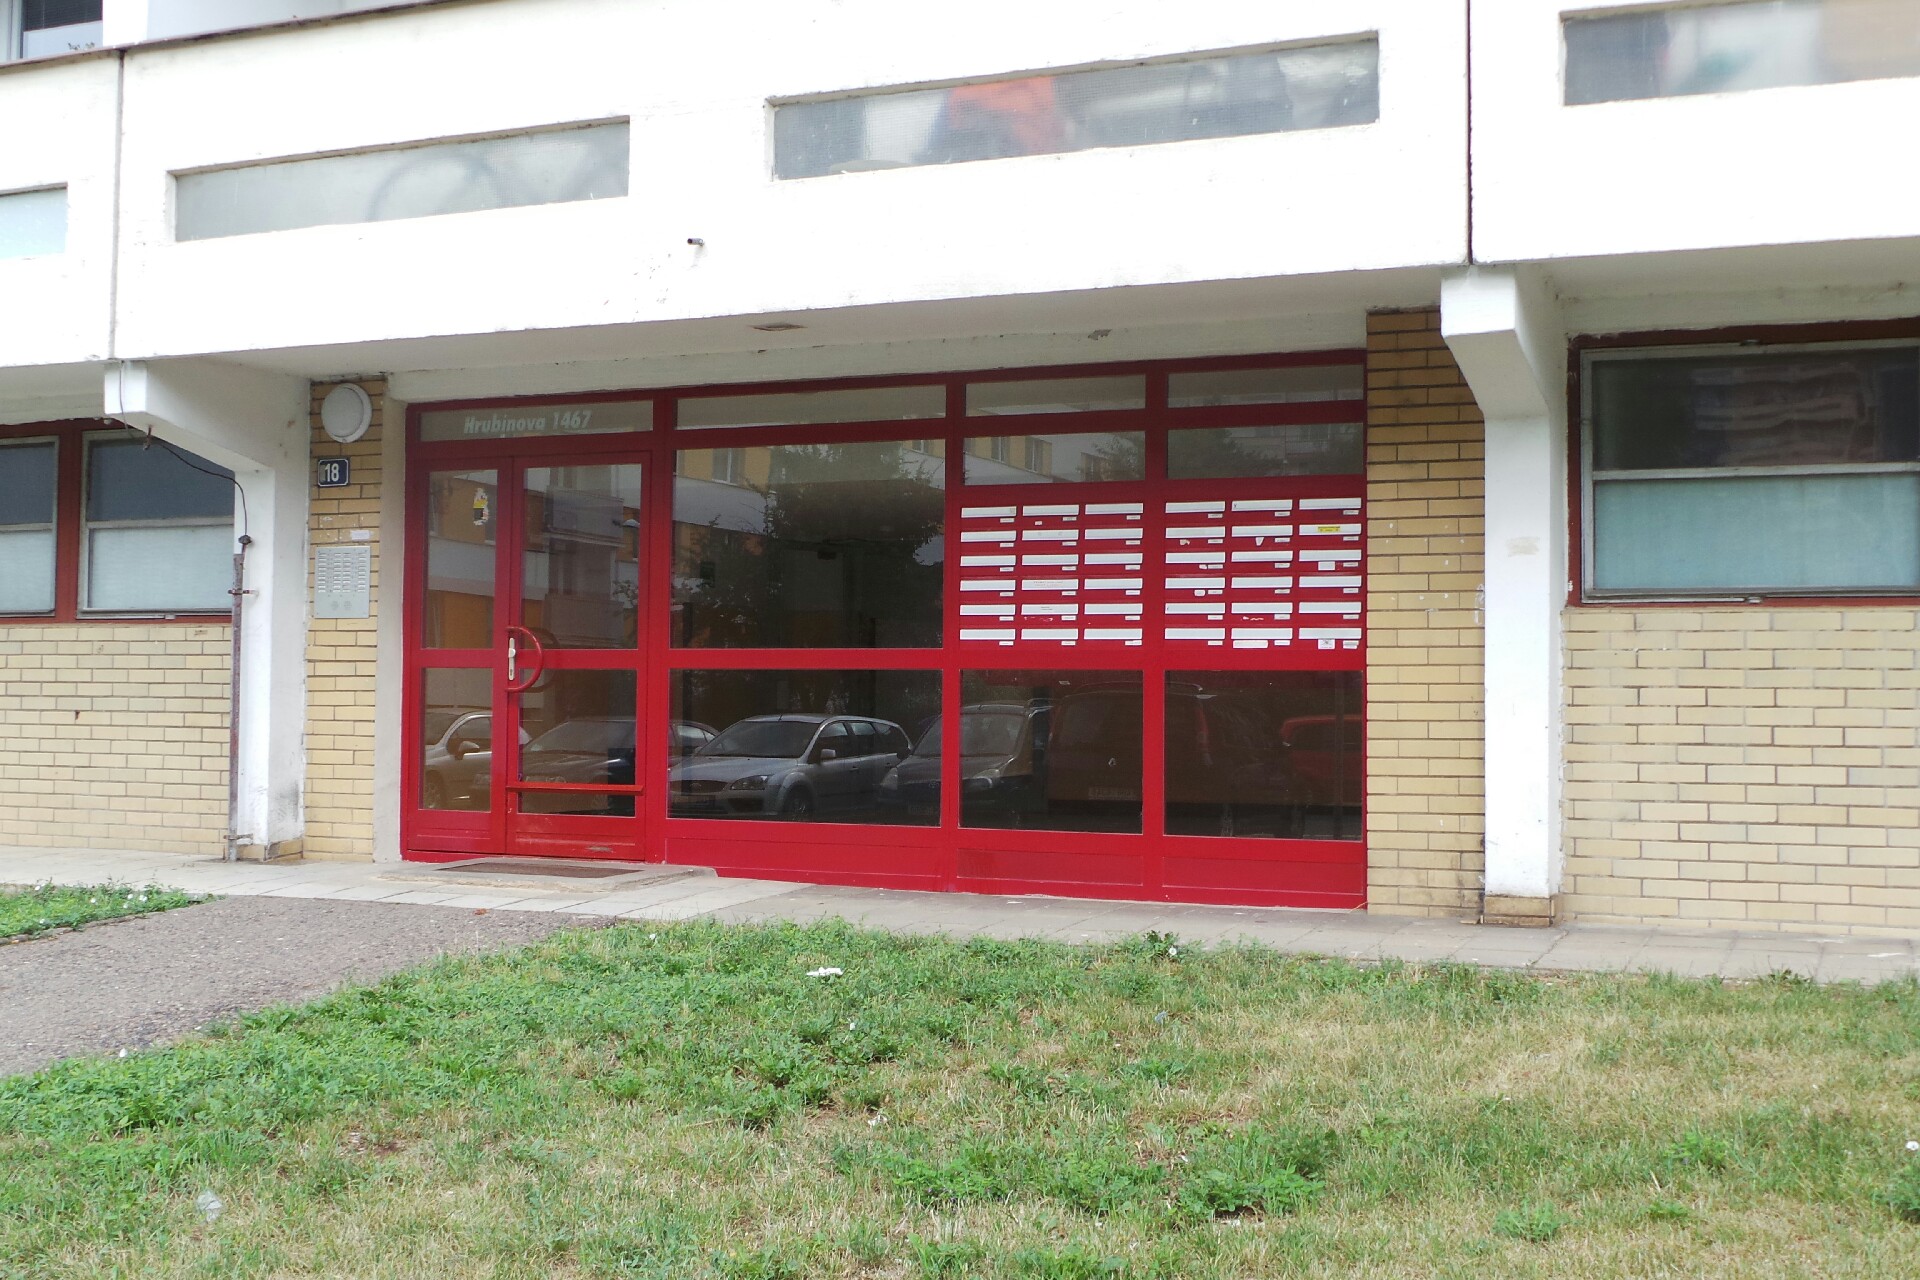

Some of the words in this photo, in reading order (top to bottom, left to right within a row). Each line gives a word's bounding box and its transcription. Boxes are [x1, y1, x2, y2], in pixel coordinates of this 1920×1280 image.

[463, 412, 546, 434] Hrubinova
[553, 410, 592, 430] 1467
[324, 463, 339, 482] 18
